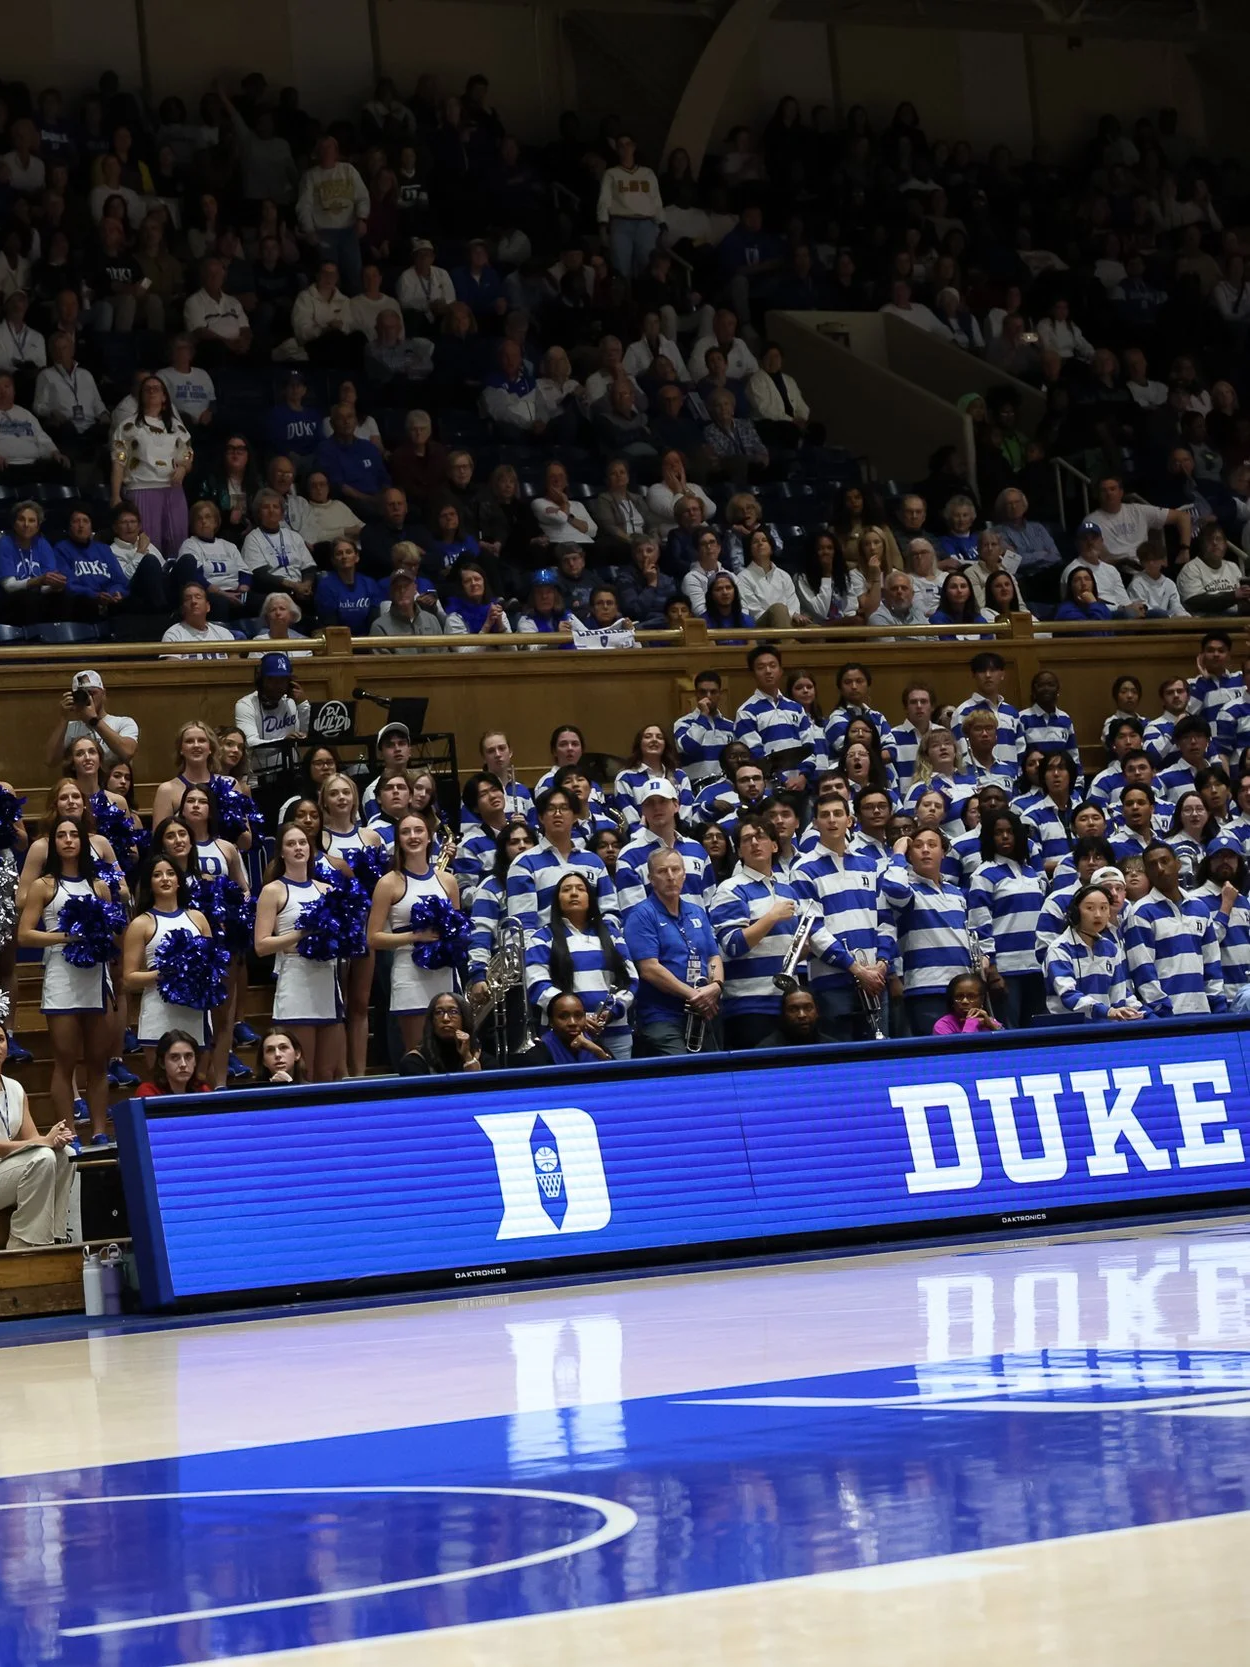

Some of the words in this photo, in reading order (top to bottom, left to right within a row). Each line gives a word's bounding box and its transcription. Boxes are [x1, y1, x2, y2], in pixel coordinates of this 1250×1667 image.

[74, 559, 111, 580] DUKE
[326, 705, 341, 717] DJ
[263, 714, 297, 733] Duke
[650, 782, 660, 790] D
[690, 918, 702, 928] D
[888, 1059, 1245, 1194] DUKE
[473, 1107, 612, 1240] D
[1001, 1213, 1047, 1224] DAKTRONICS
[454, 1267, 507, 1280] DAKTRONICS
